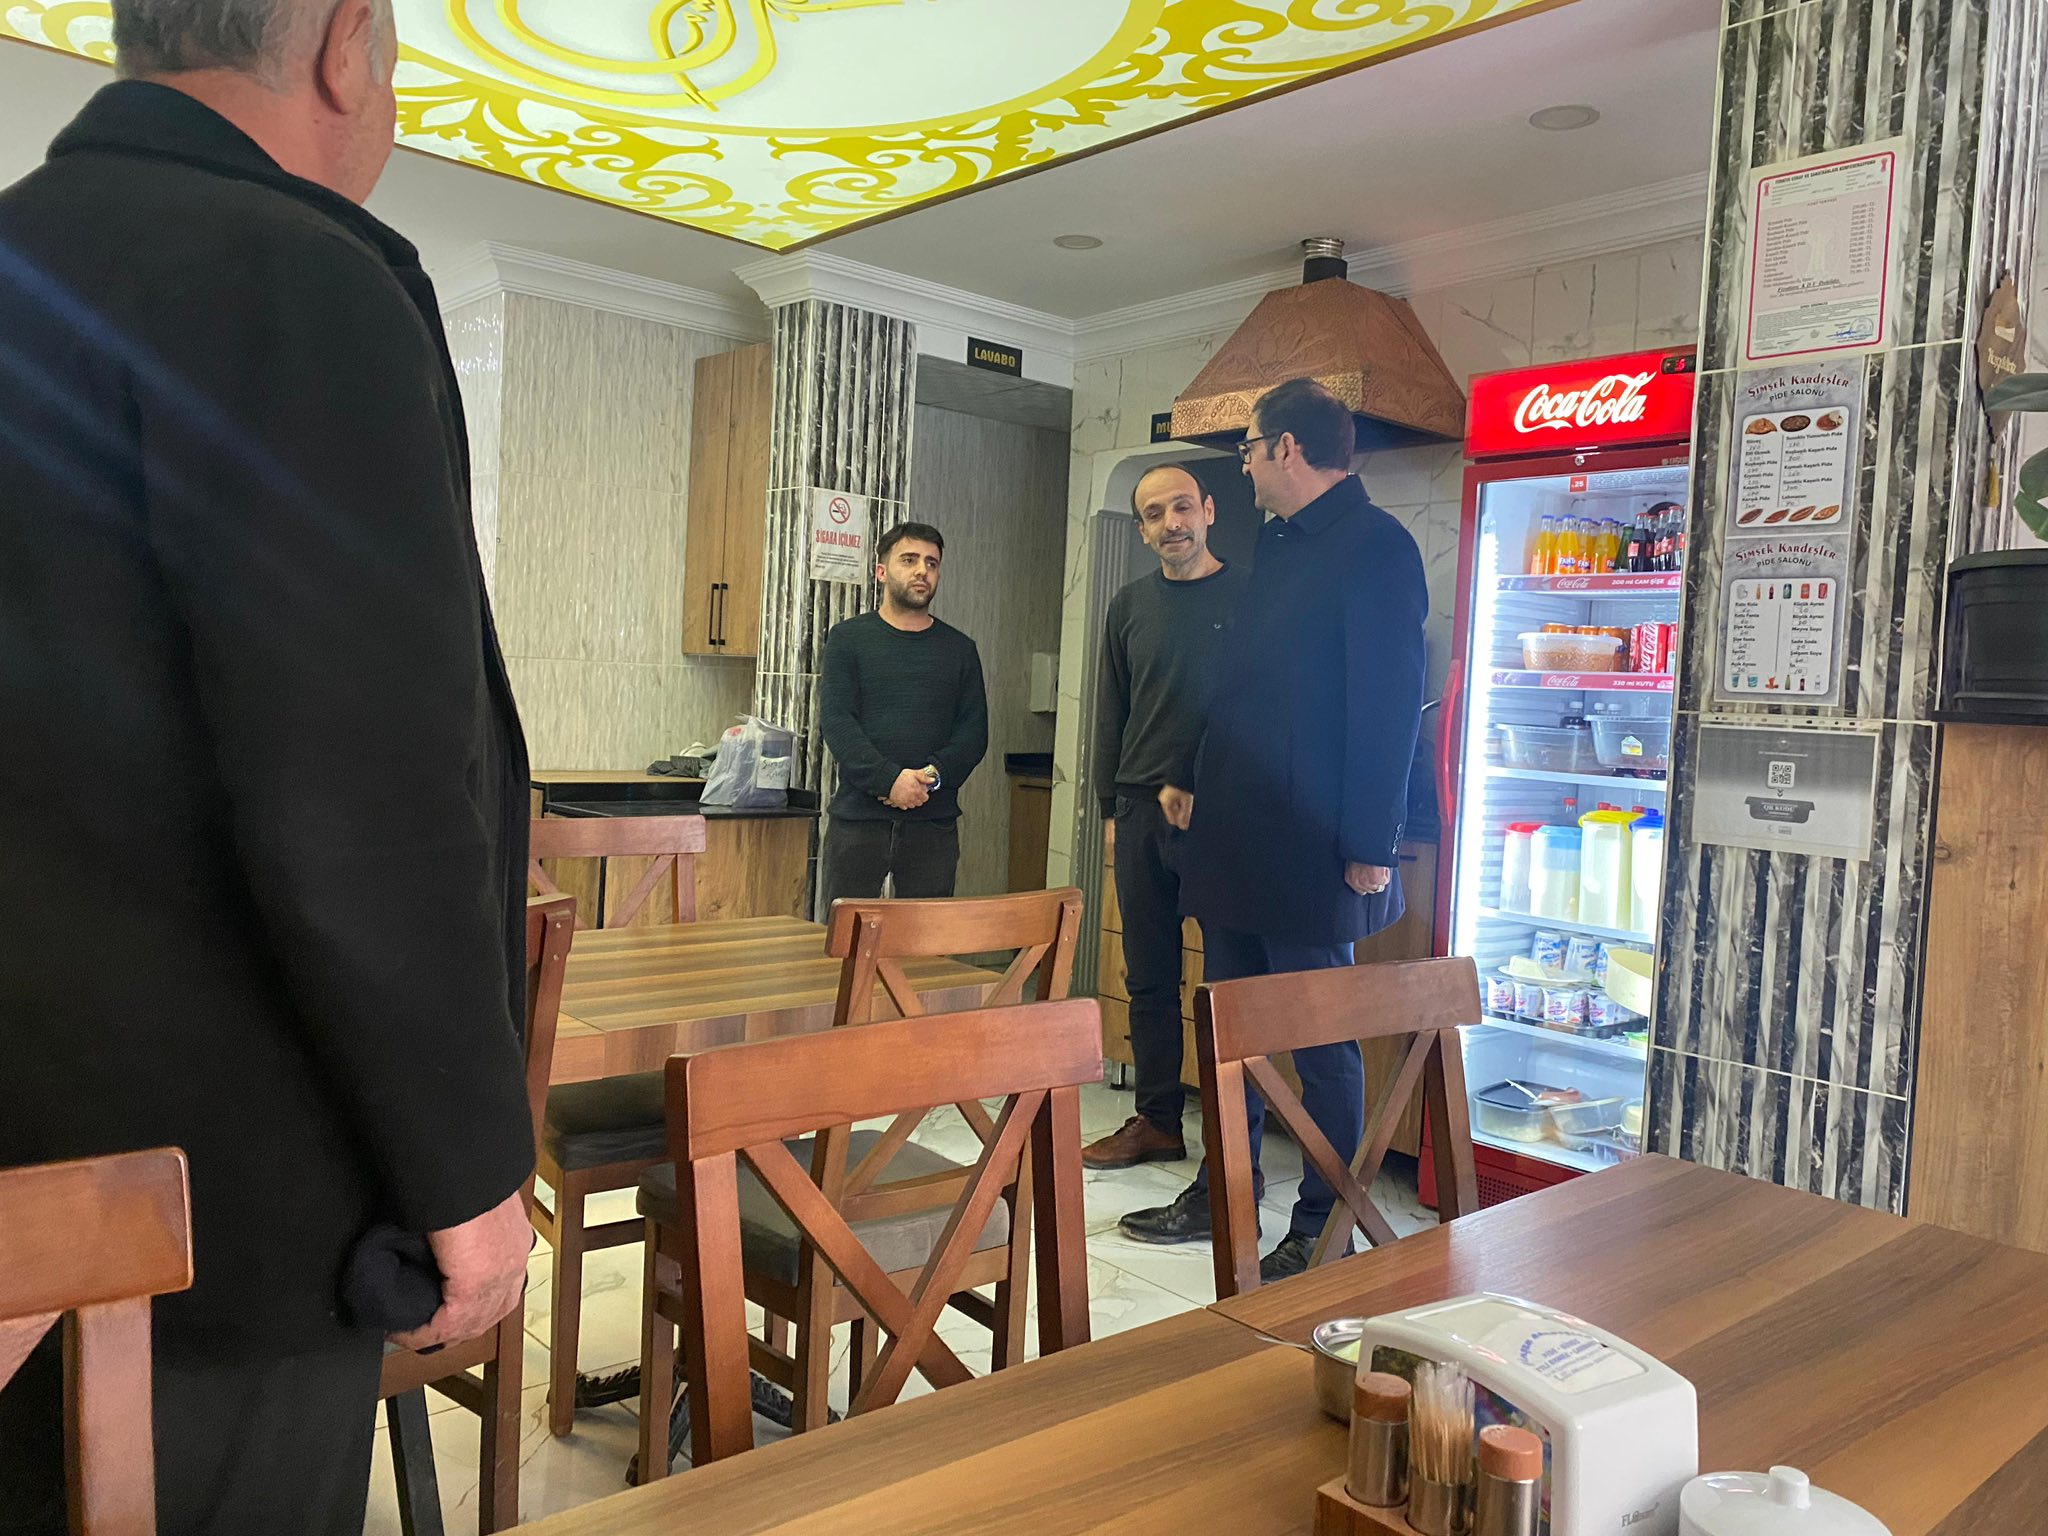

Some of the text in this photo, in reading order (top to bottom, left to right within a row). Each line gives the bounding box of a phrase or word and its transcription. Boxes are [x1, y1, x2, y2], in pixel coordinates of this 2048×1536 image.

[974, 346, 1016, 368] LAVABO
[1790, 388, 1825, 397] SALONU
[1514, 371, 1657, 434] Coca-Cola
[816, 527, 862, 549] SİGARA İÇİLMEZ
[1778, 557, 1812, 567] SALONU
[1556, 578, 1591, 590] Coca-Cola
[1547, 676, 1580, 687] Coca-Cola
